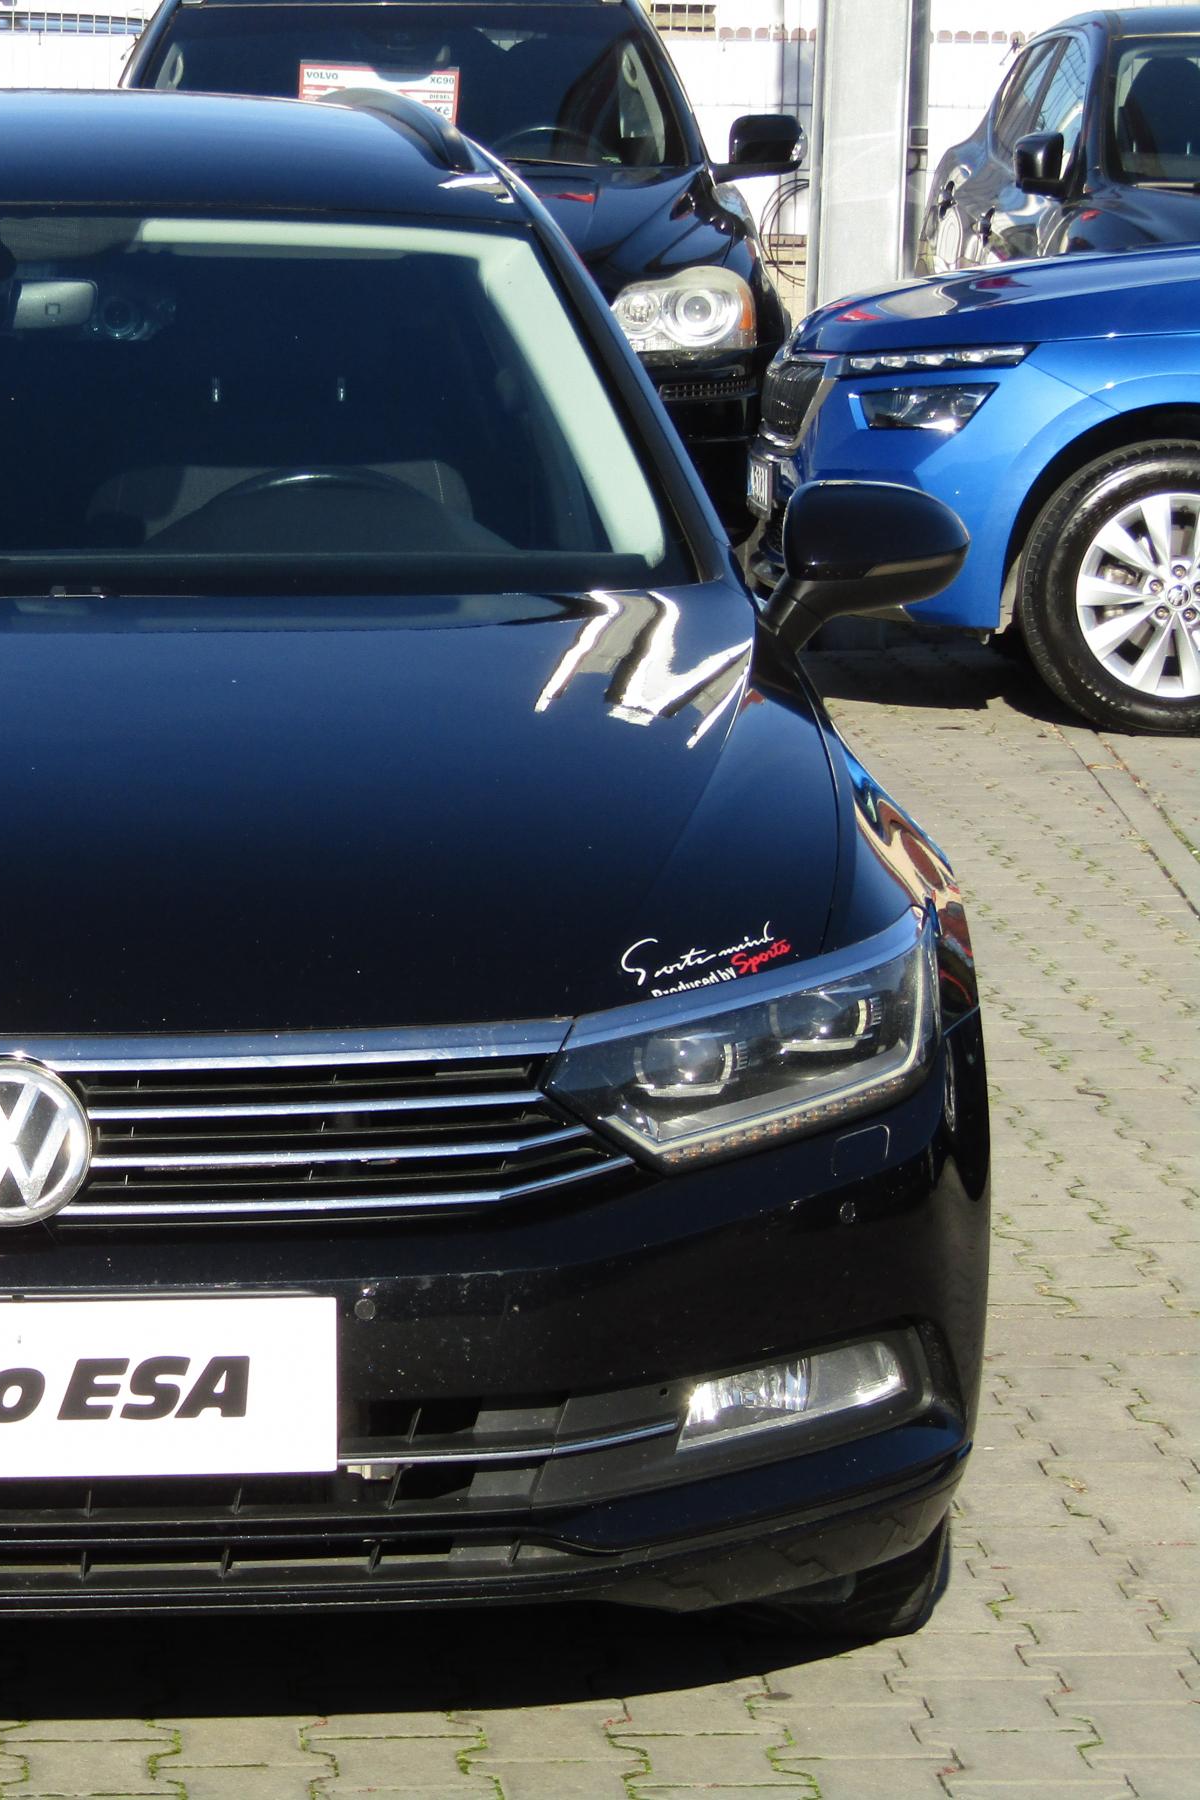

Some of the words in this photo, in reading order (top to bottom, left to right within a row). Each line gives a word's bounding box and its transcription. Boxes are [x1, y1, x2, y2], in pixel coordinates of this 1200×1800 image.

[306, 72, 338, 80] VOLVO
[430, 76, 455, 85] XC90
[718, 920, 775, 957] mind
[730, 938, 792, 974] Sports
[56, 1355, 251, 1421] ESA
